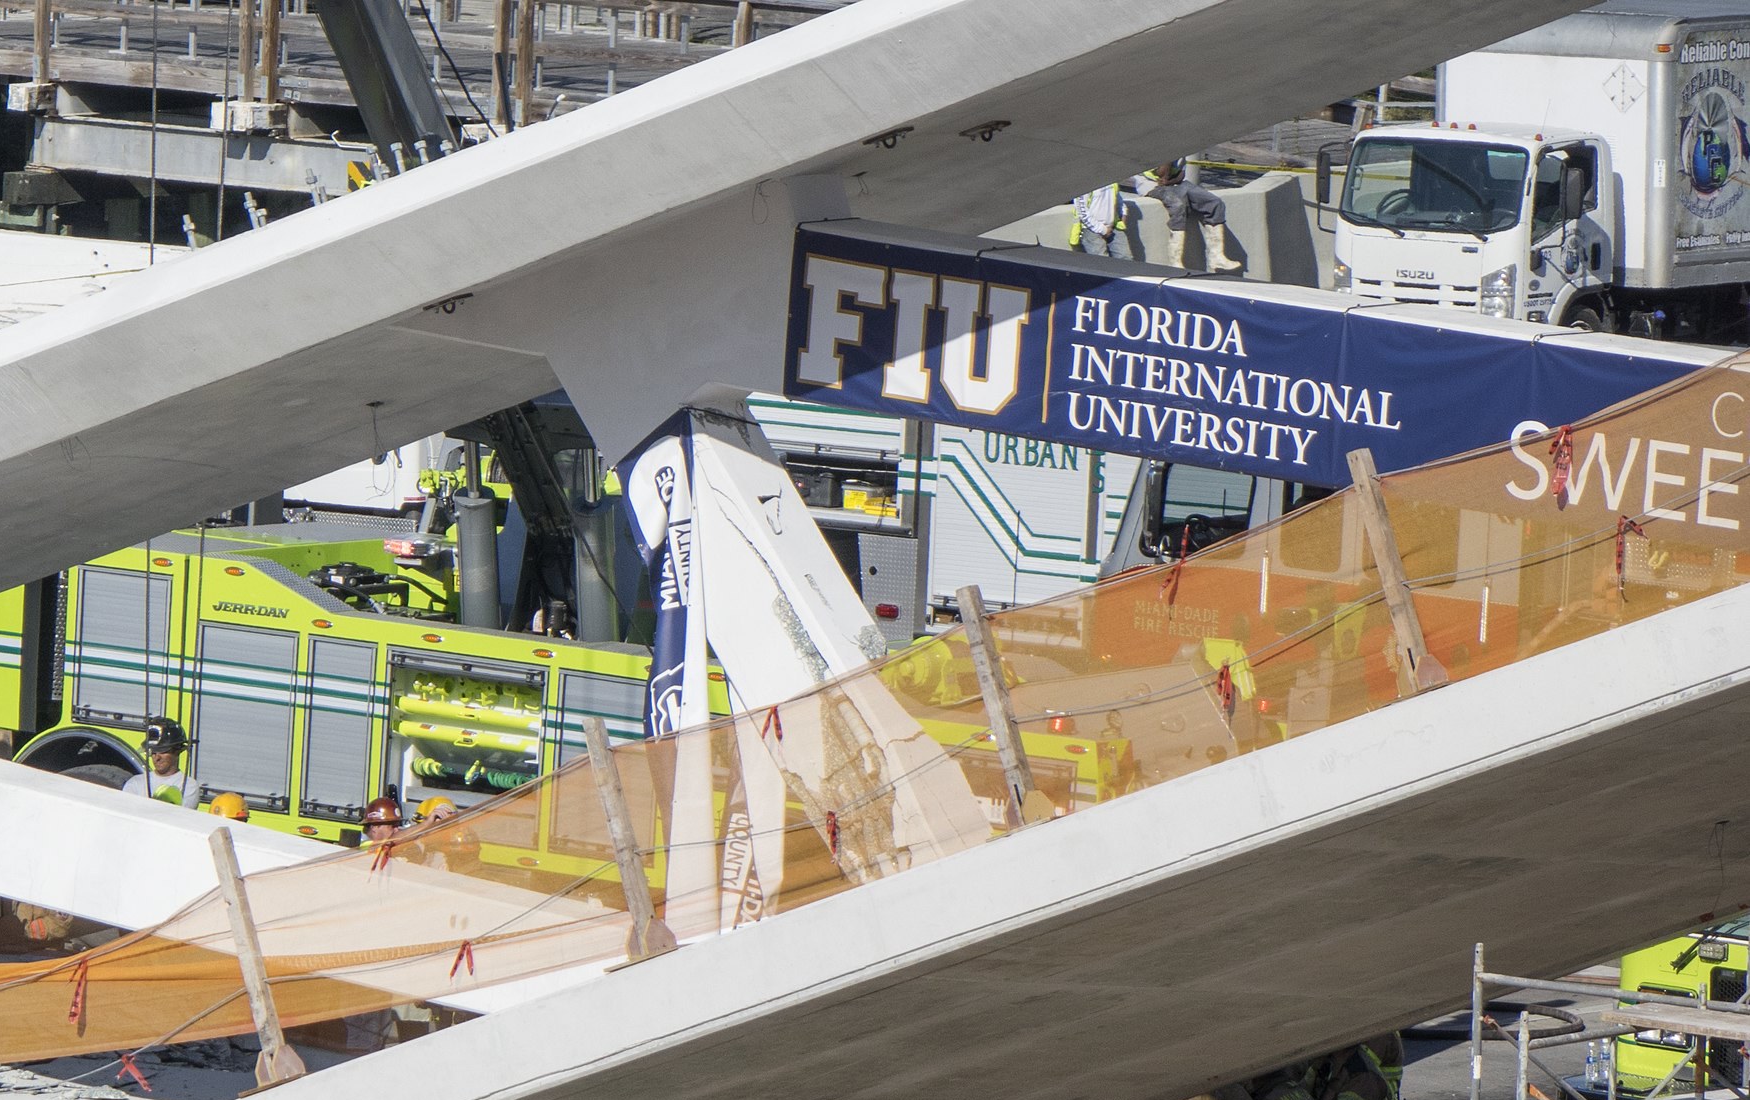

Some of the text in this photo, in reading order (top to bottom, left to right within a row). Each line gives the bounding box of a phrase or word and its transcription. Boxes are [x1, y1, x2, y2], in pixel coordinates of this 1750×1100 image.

[1681, 40, 1727, 64] Reliable
[1396, 268, 1435, 280] ISUZU
[796, 252, 1031, 415] FIU
[1072, 295, 1248, 357] FLORIDA
[1068, 343, 1401, 430] INTERNATIONAL
[982, 431, 1079, 471] URBAN
[1068, 392, 1317, 466] UNIVERSITY
[1505, 420, 1744, 530] SWEE
[1133, 616, 1219, 639] FIRE RESCUE
